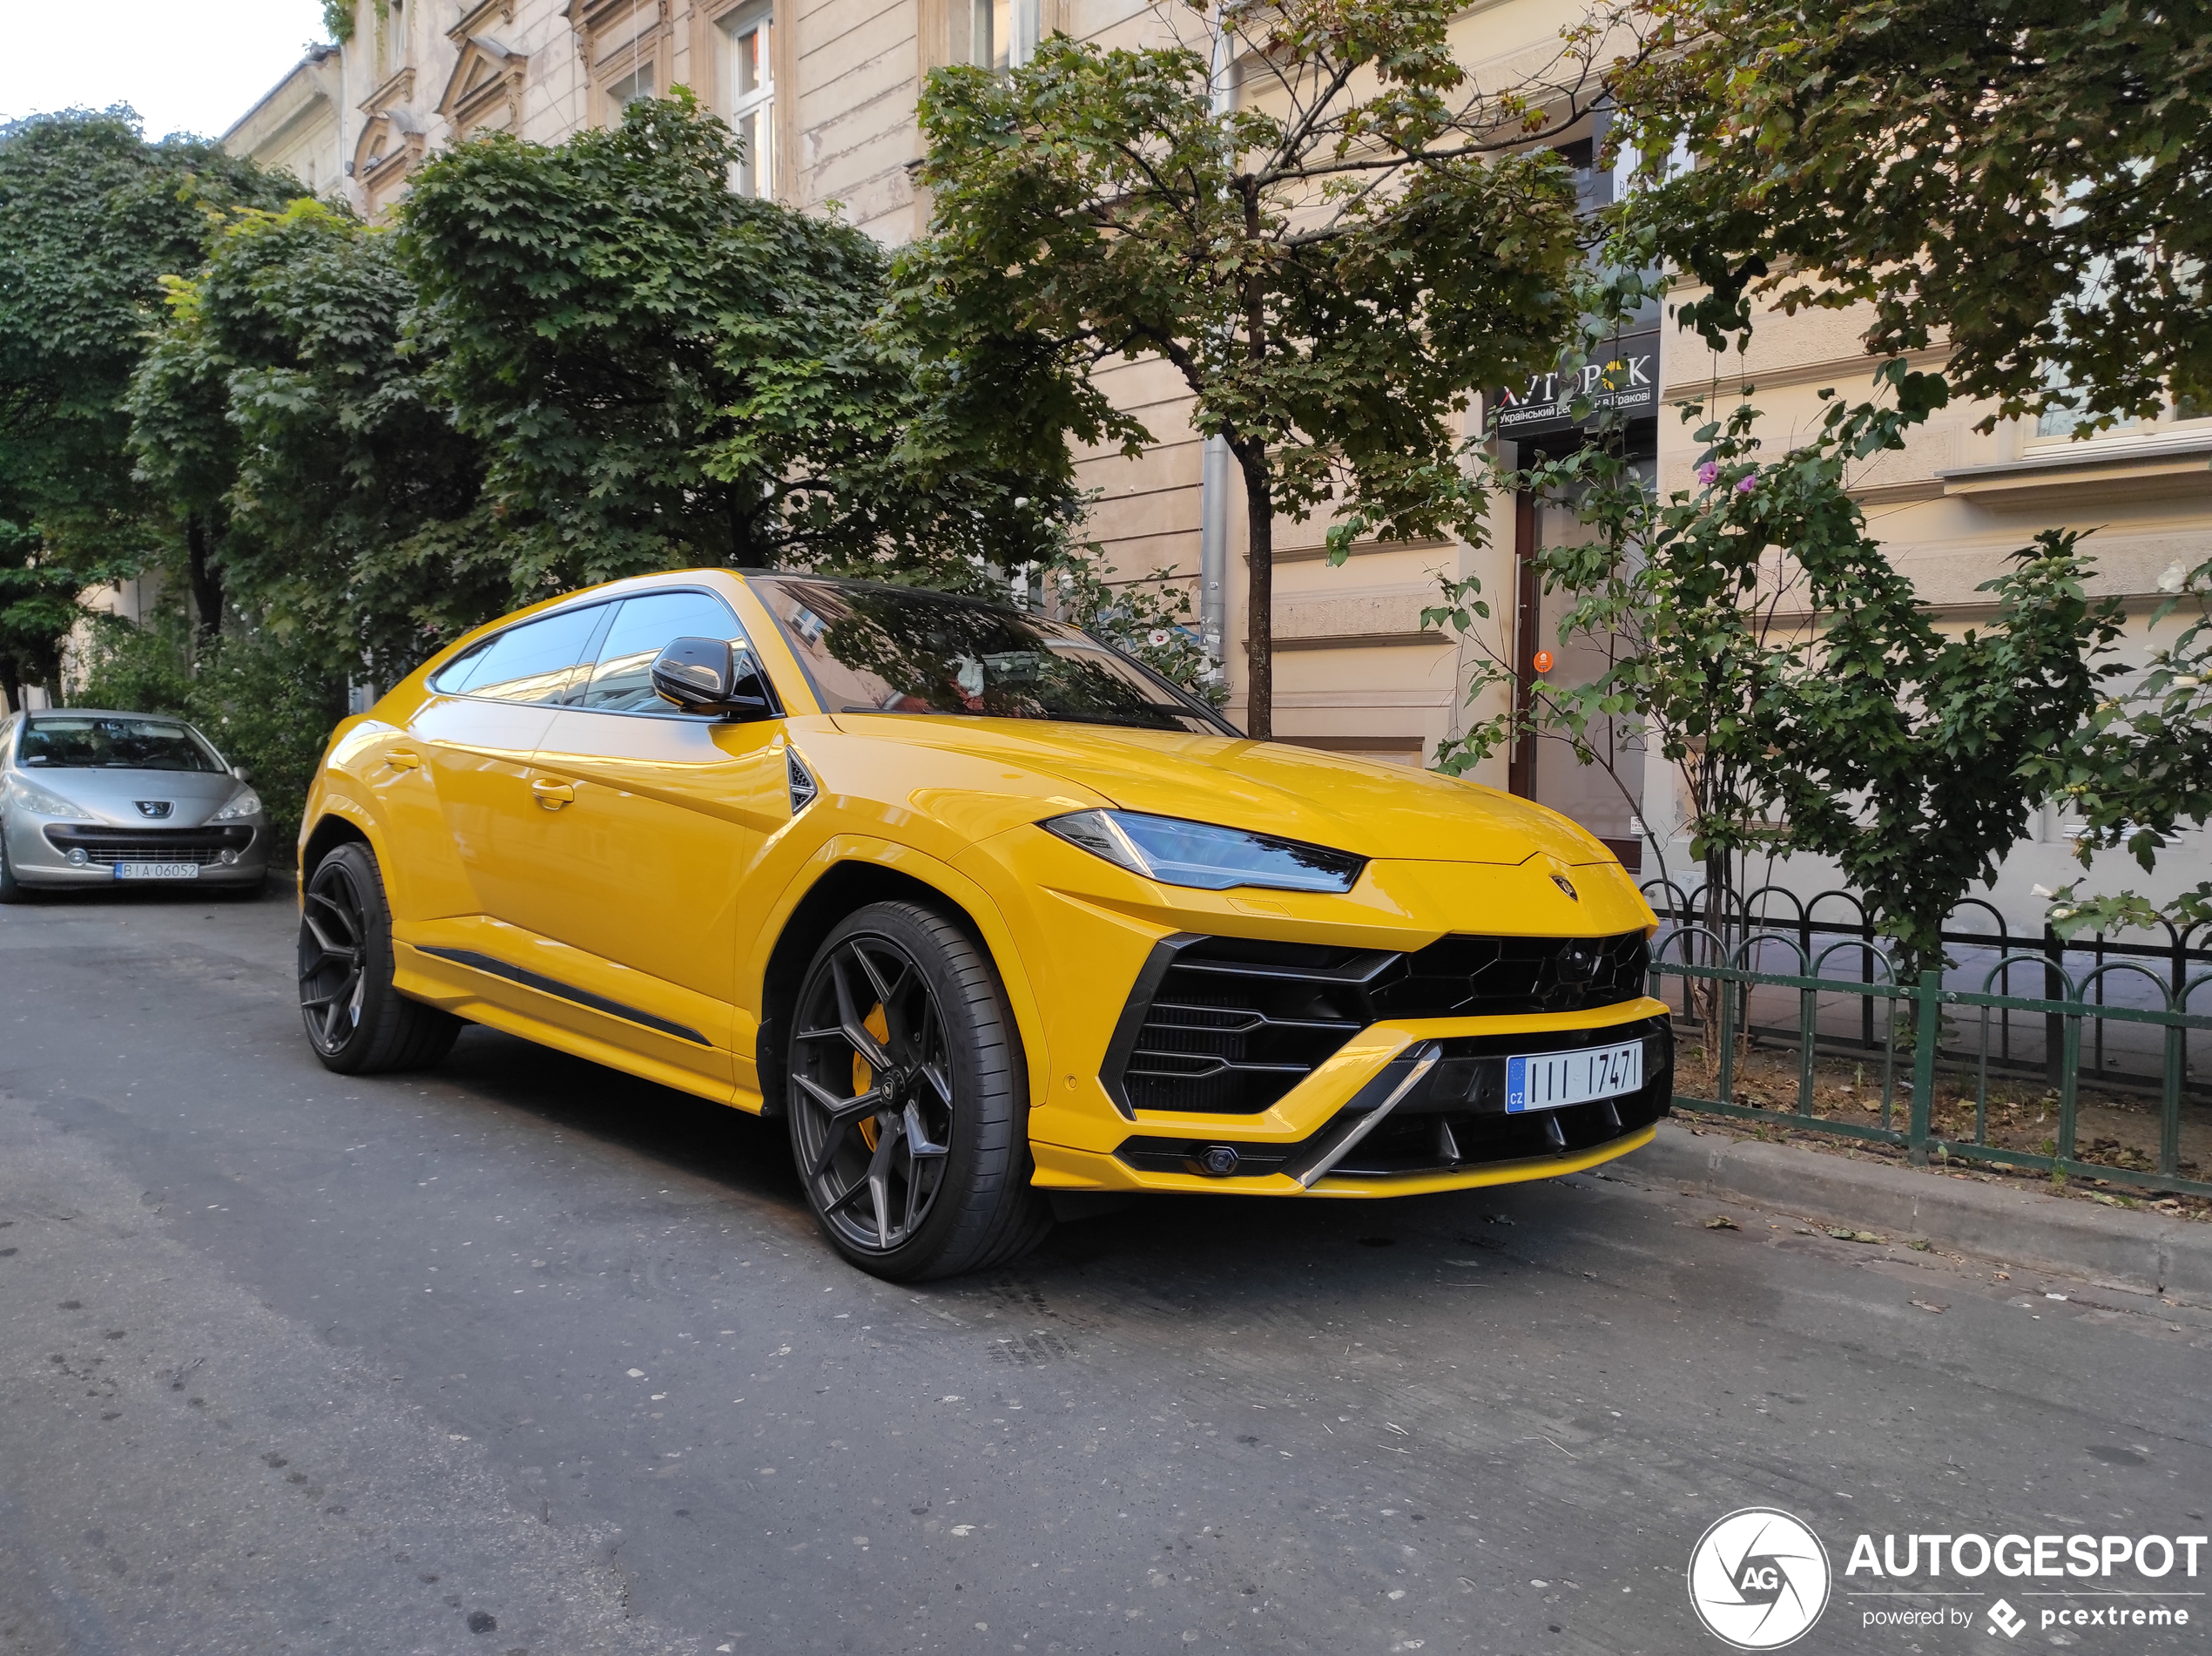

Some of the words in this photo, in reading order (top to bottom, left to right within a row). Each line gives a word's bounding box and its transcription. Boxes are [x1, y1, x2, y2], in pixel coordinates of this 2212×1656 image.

[1557, 398, 1601, 416] ресн
[124, 865, 150, 876] BIA
[155, 865, 196, 876] 06052
[1510, 1092, 1523, 1105] CZ
